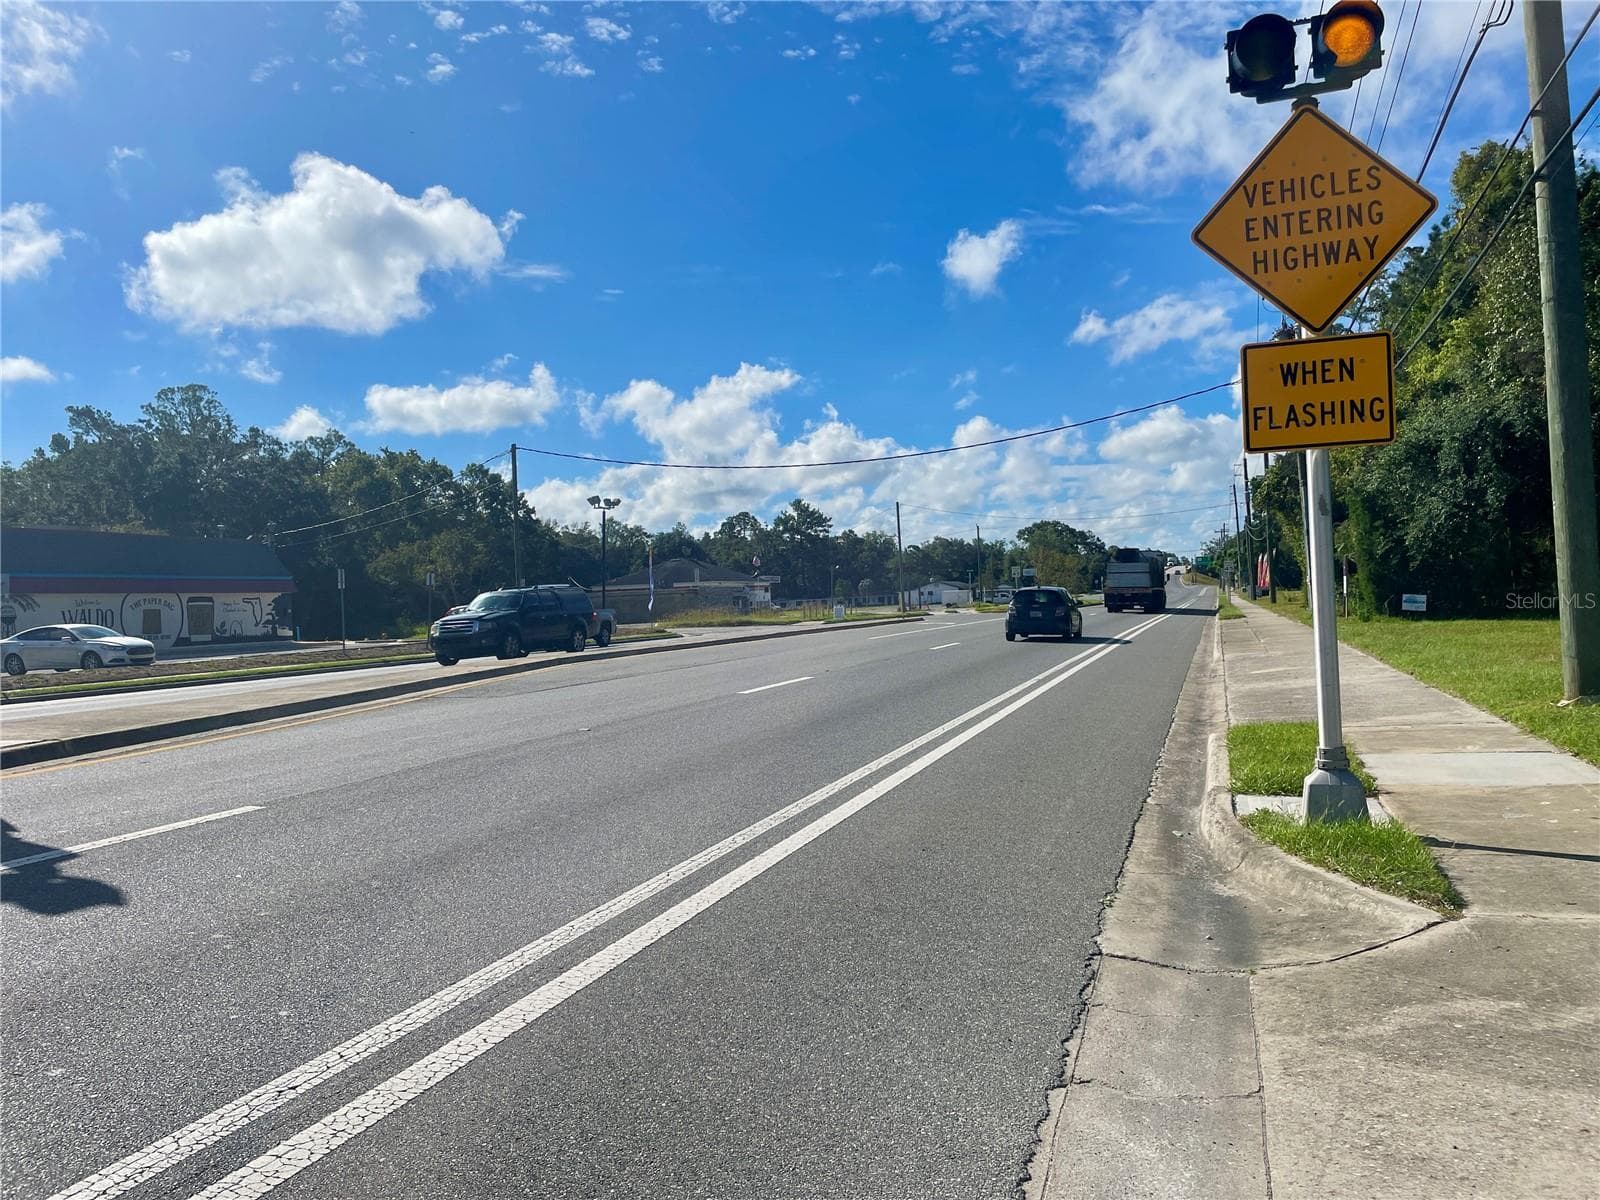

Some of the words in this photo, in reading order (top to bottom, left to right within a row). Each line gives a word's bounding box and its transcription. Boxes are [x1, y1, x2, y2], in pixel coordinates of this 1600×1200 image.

[1242, 165, 1381, 208] VEHICLES
[1245, 200, 1384, 242] ENTERING
[1252, 234, 1380, 275] HIGHWAY
[1279, 356, 1355, 387] WHEN
[1252, 396, 1385, 431] FLASHING
